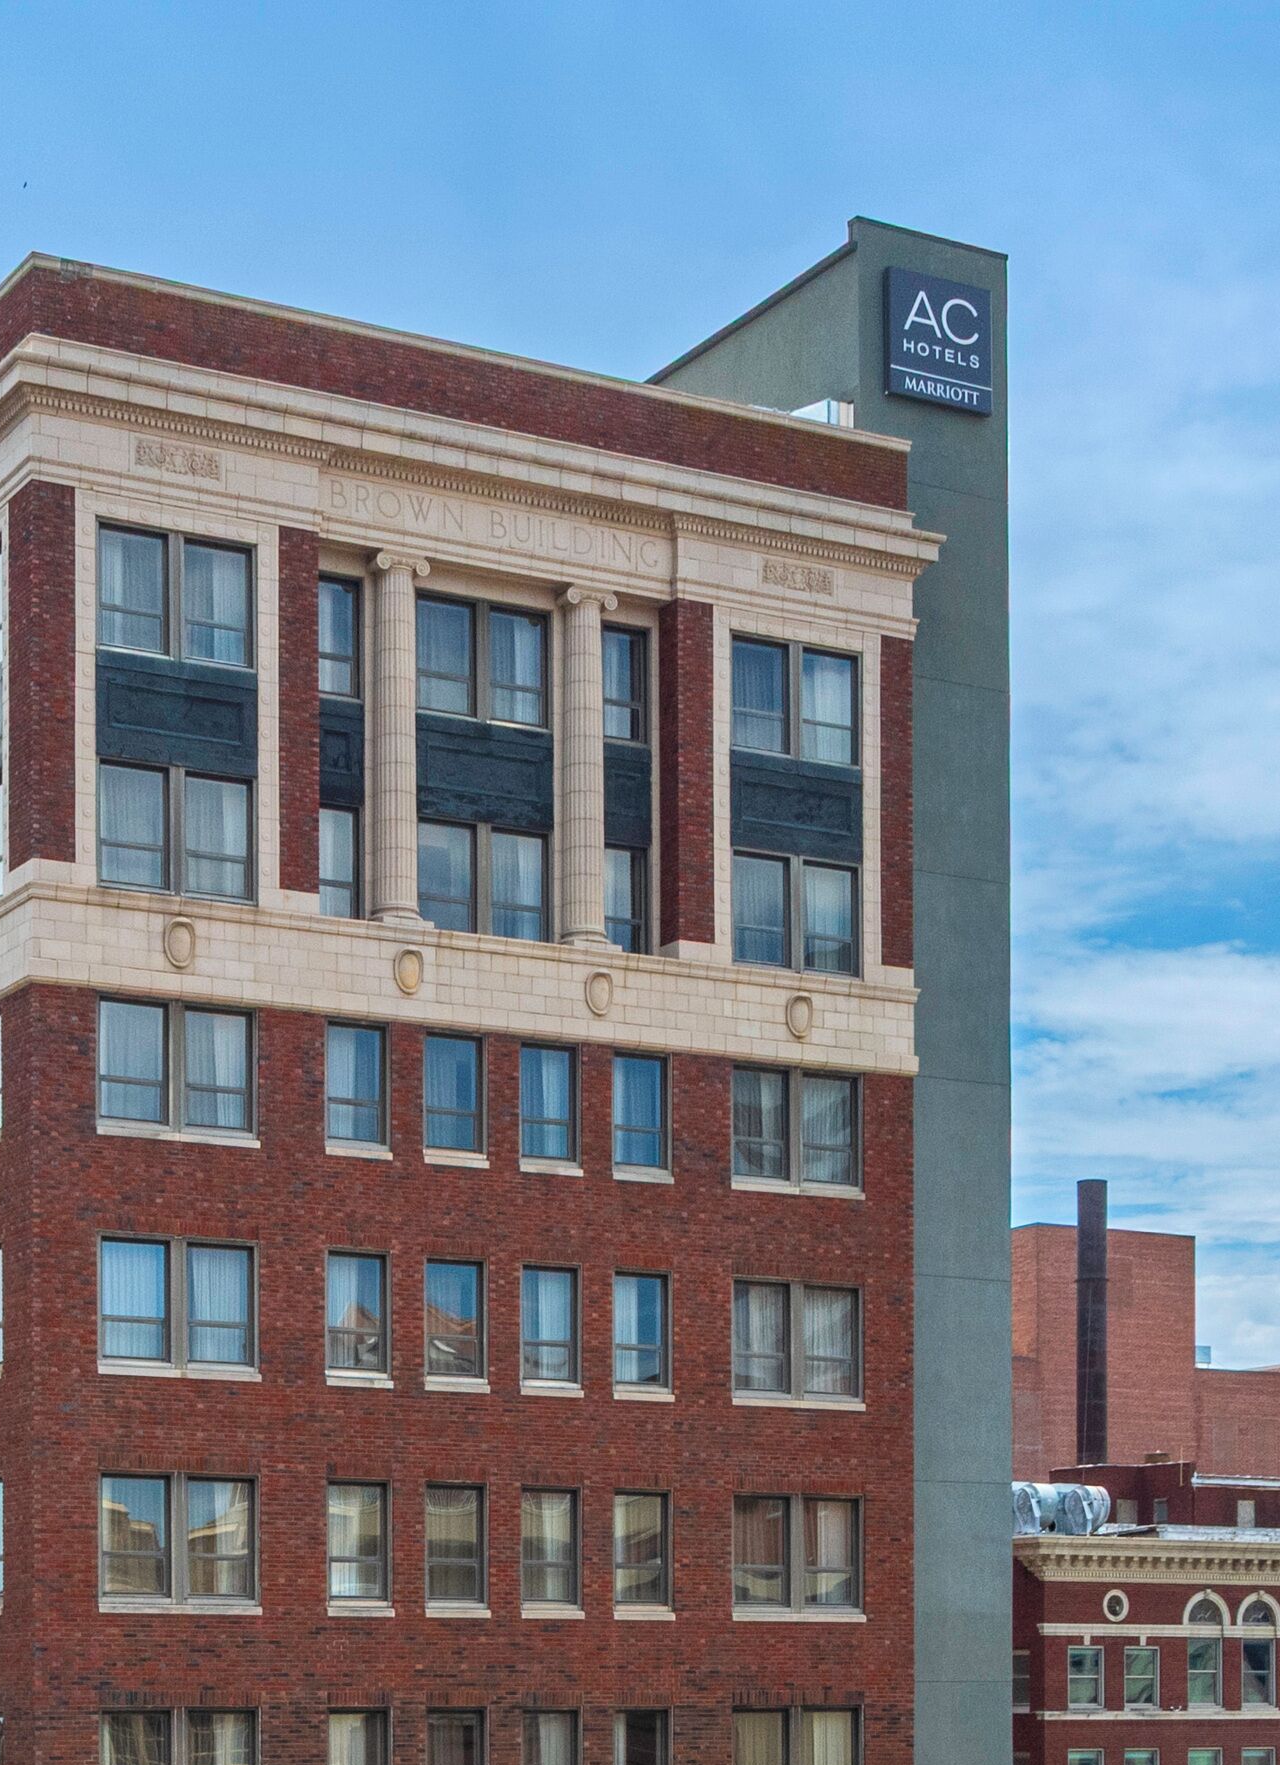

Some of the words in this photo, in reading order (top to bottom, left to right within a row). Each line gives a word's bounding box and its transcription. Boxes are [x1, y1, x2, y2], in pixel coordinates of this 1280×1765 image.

[904, 290, 980, 345] AC
[903, 338, 980, 369] HOTELS
[904, 376, 980, 405] MARRIOTT
[329, 479, 465, 534] BROWN
[490, 509, 659, 569] BUILDING
